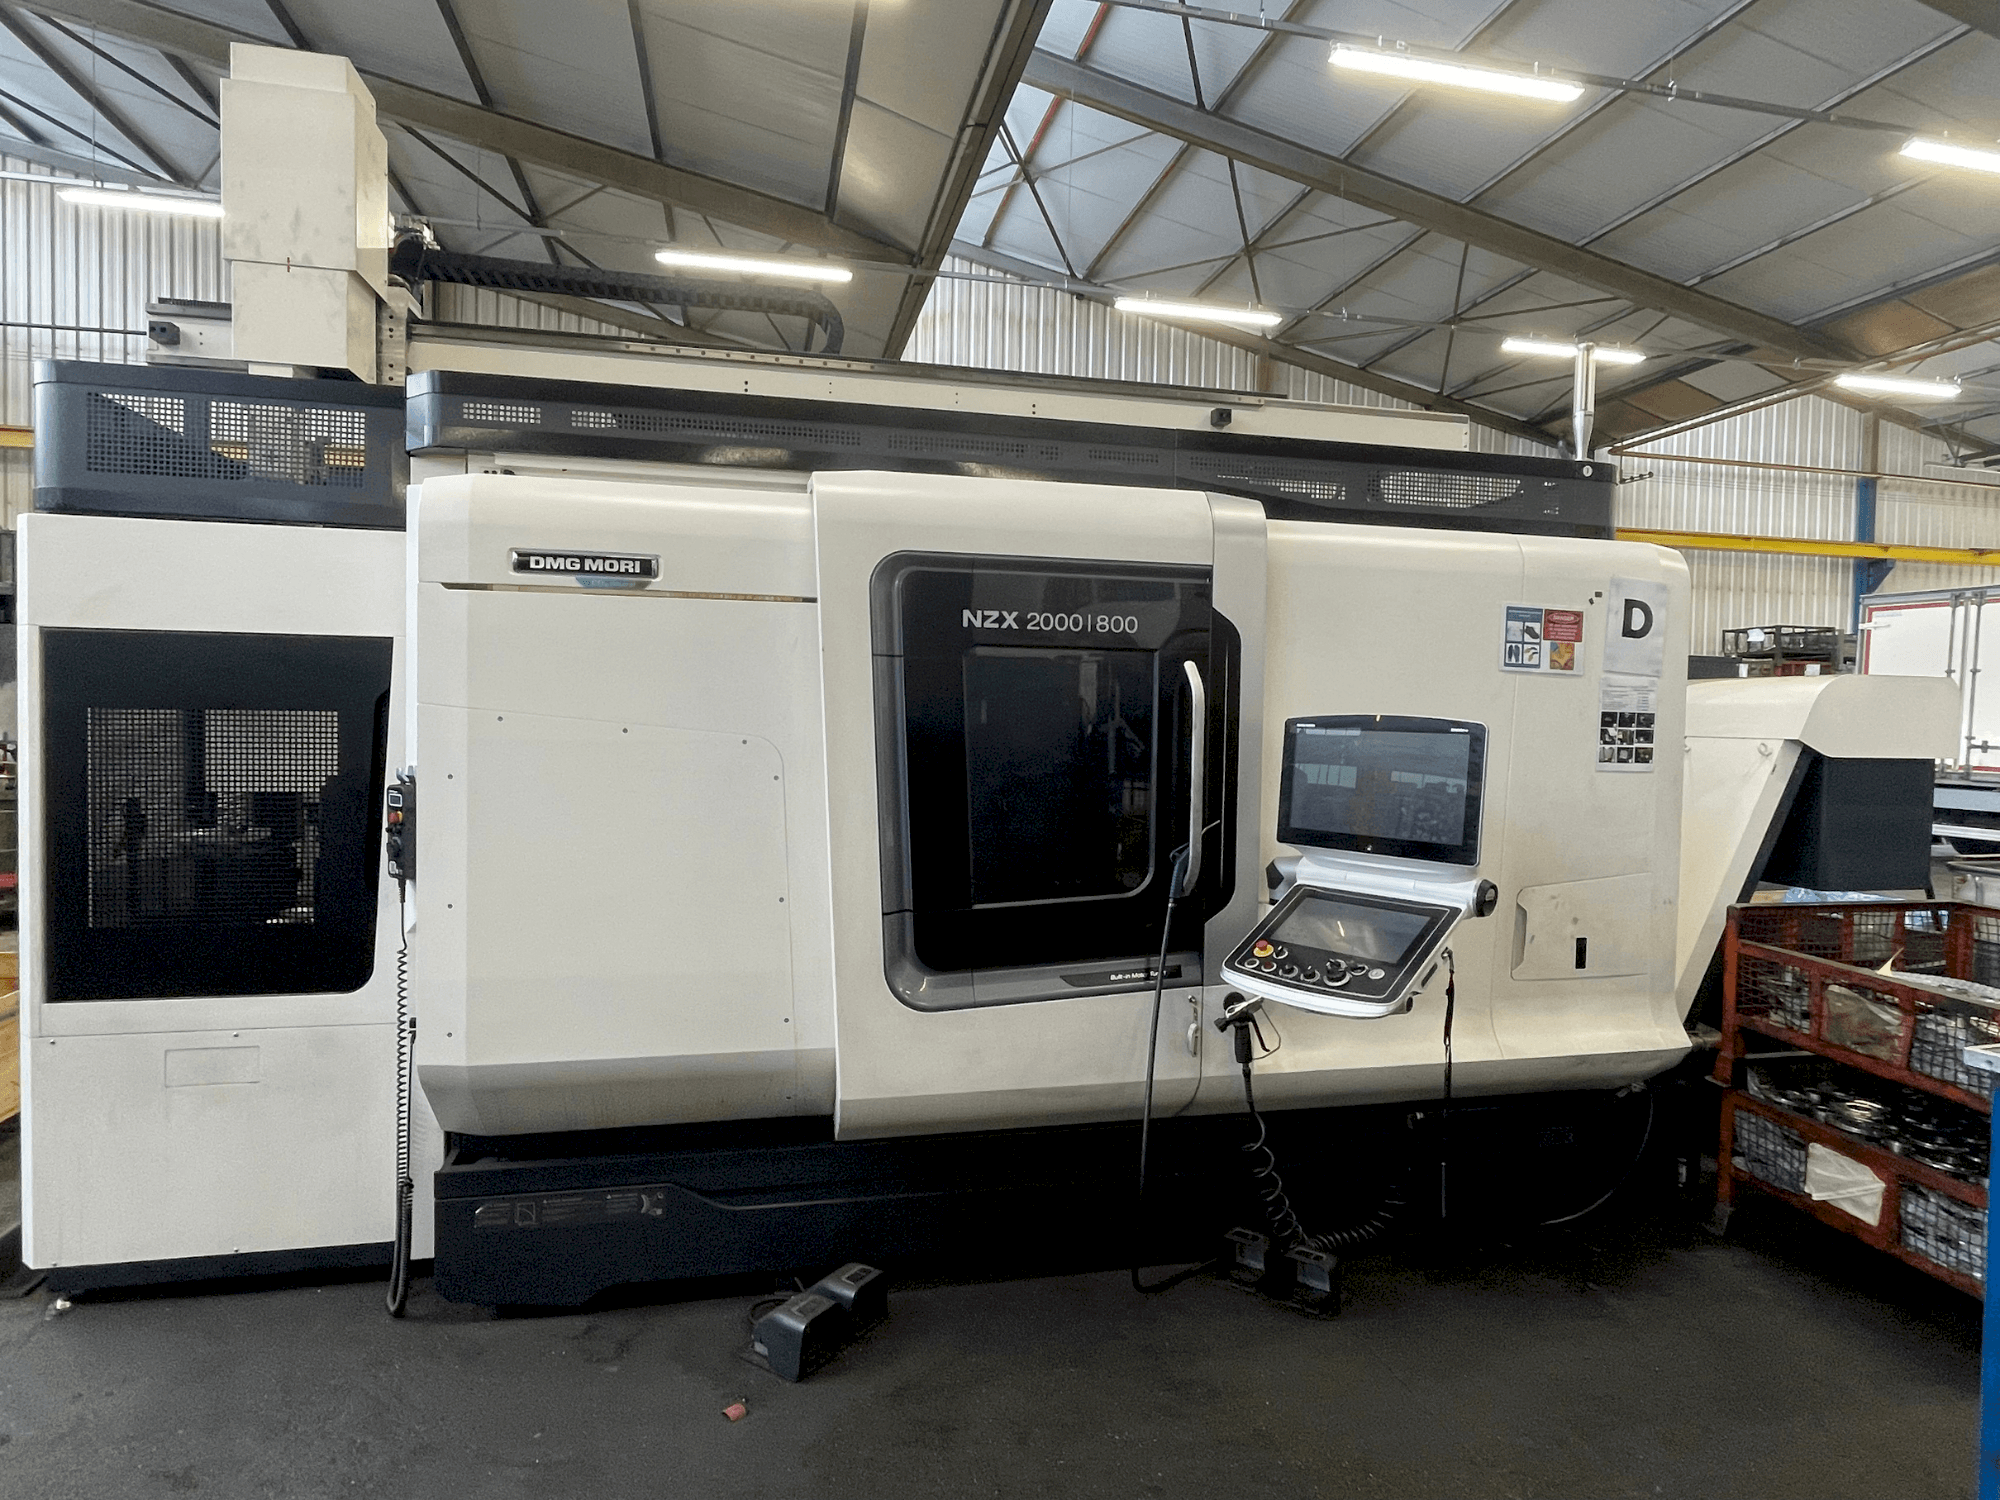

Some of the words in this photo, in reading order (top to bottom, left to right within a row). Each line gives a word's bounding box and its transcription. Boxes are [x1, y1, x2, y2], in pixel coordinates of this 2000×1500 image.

[529, 555, 581, 571] DMG
[584, 558, 641, 574] MORI
[962, 609, 1019, 630] NZX
[1621, 599, 1653, 639] D
